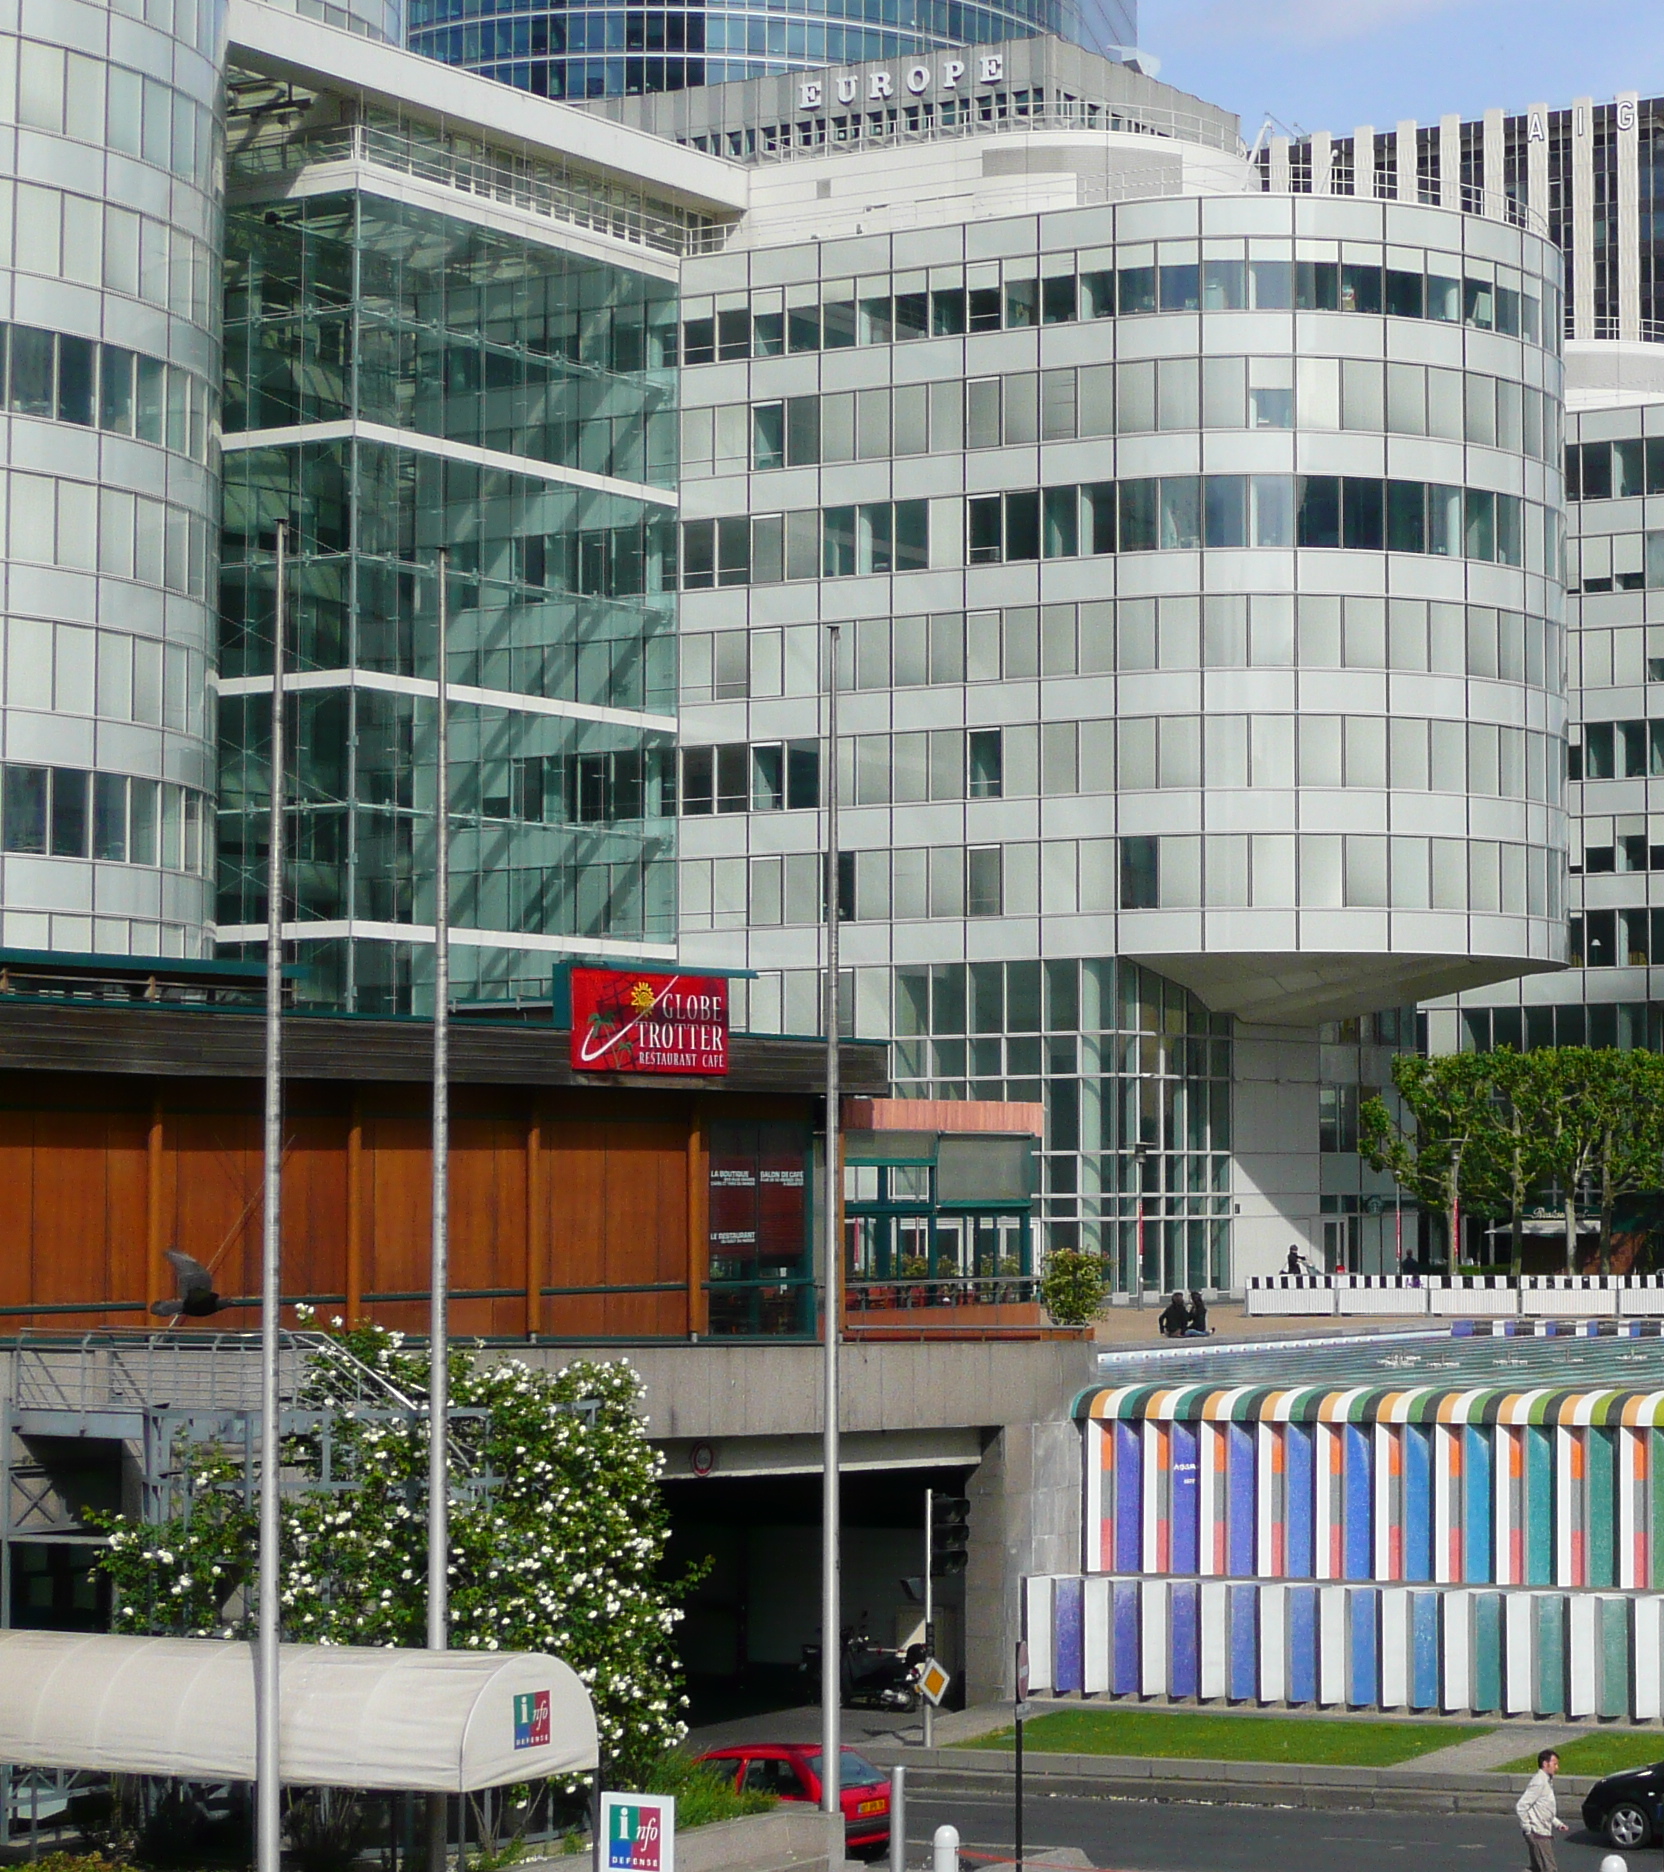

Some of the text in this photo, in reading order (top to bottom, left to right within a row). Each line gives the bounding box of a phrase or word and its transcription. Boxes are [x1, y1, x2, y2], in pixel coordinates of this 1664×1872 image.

[800, 55, 1003, 109] EUROPE
[1527, 100, 1634, 142] AIG
[662, 993, 722, 1022] GLOBE
[635, 1021, 724, 1051] TROTTER
[639, 1051, 725, 1068] RESTAURANT CAFÉ
[710, 1170, 719, 1178] LA
[618, 1807, 659, 1853] info
[611, 1855, 658, 1868] DEFENSE
